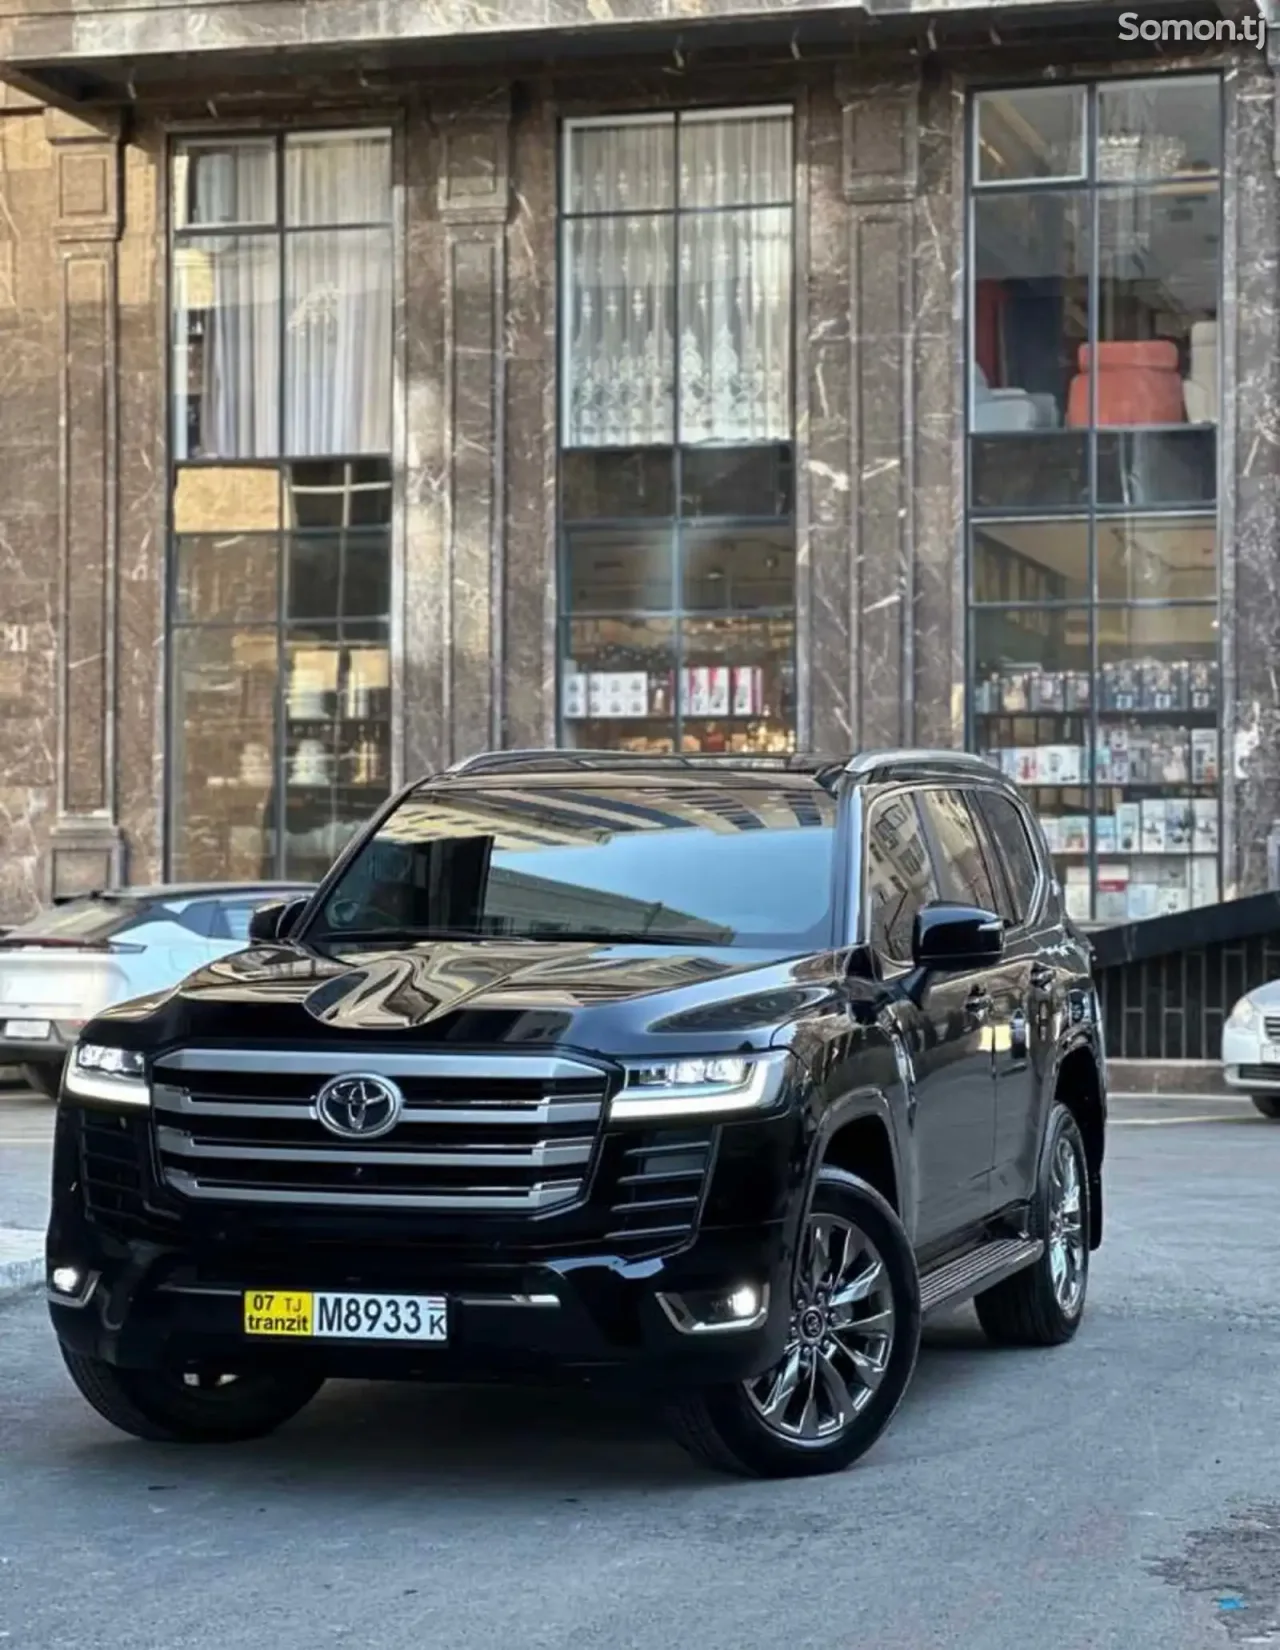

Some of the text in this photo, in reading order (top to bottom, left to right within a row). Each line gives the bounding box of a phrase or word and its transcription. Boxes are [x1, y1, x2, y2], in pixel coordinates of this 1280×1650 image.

[252, 1294, 303, 1312] 07 TJ
[247, 1314, 309, 1332] tranzit
[318, 1297, 422, 1334] M8933
[429, 1315, 446, 1335] K
